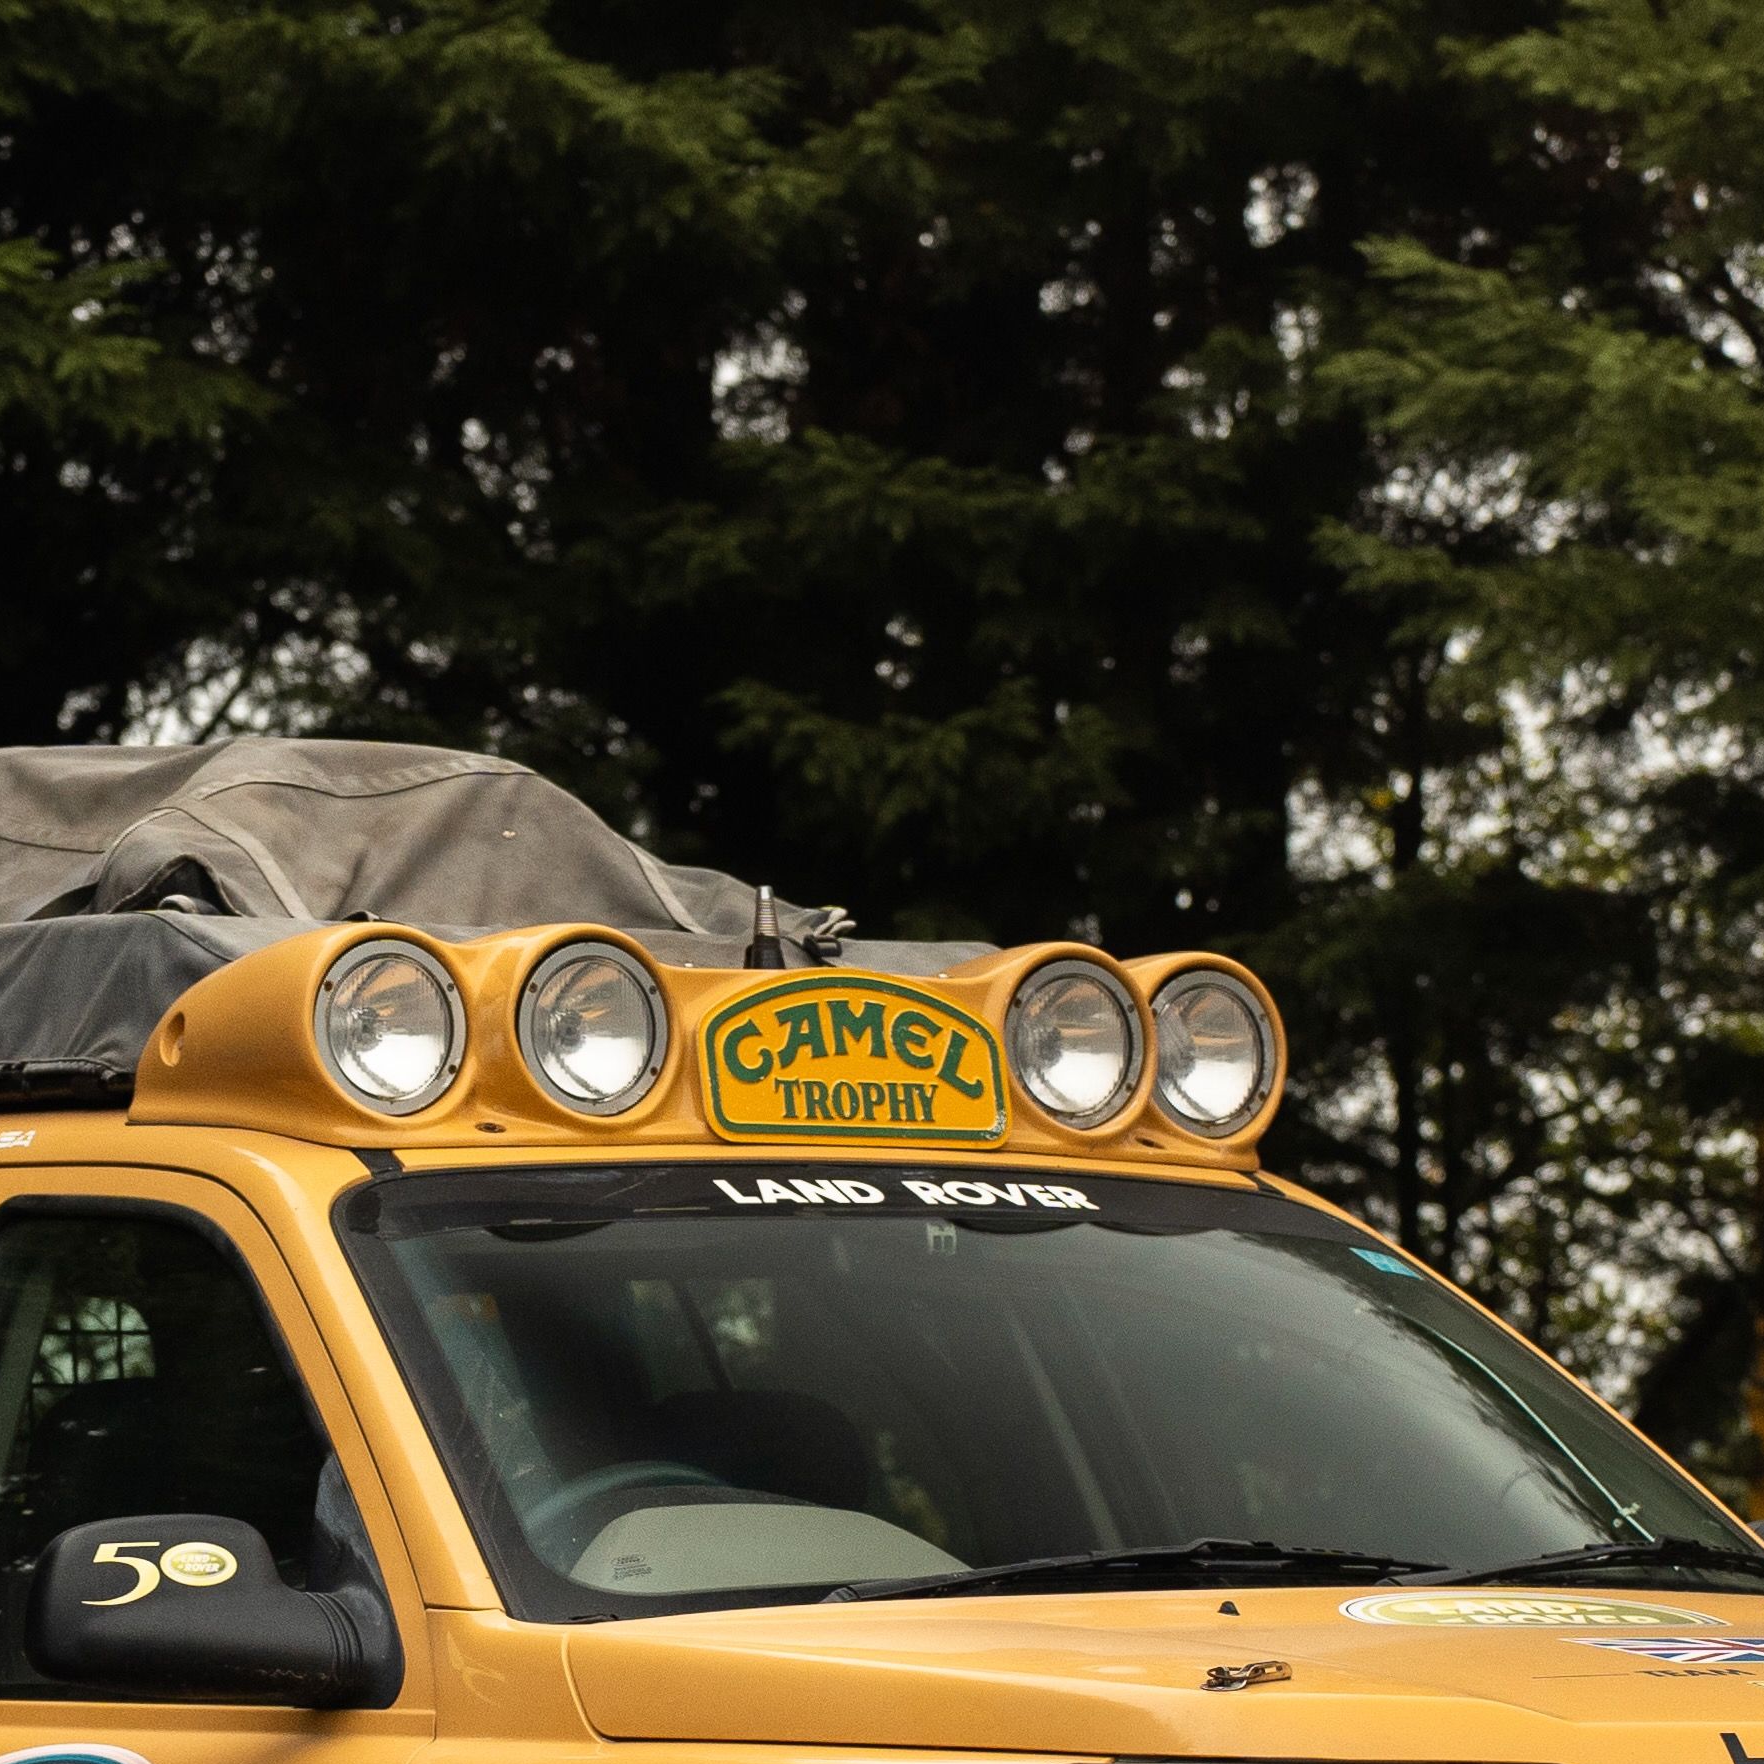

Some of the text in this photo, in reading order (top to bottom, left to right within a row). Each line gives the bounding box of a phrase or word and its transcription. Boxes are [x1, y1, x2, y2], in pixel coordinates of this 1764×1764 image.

[723, 1000, 984, 1099] CAMEL
[774, 1077, 938, 1122] TROPHY
[712, 1179, 1100, 1210] LAND ROVER
[1418, 1600, 1577, 1615] LAND
